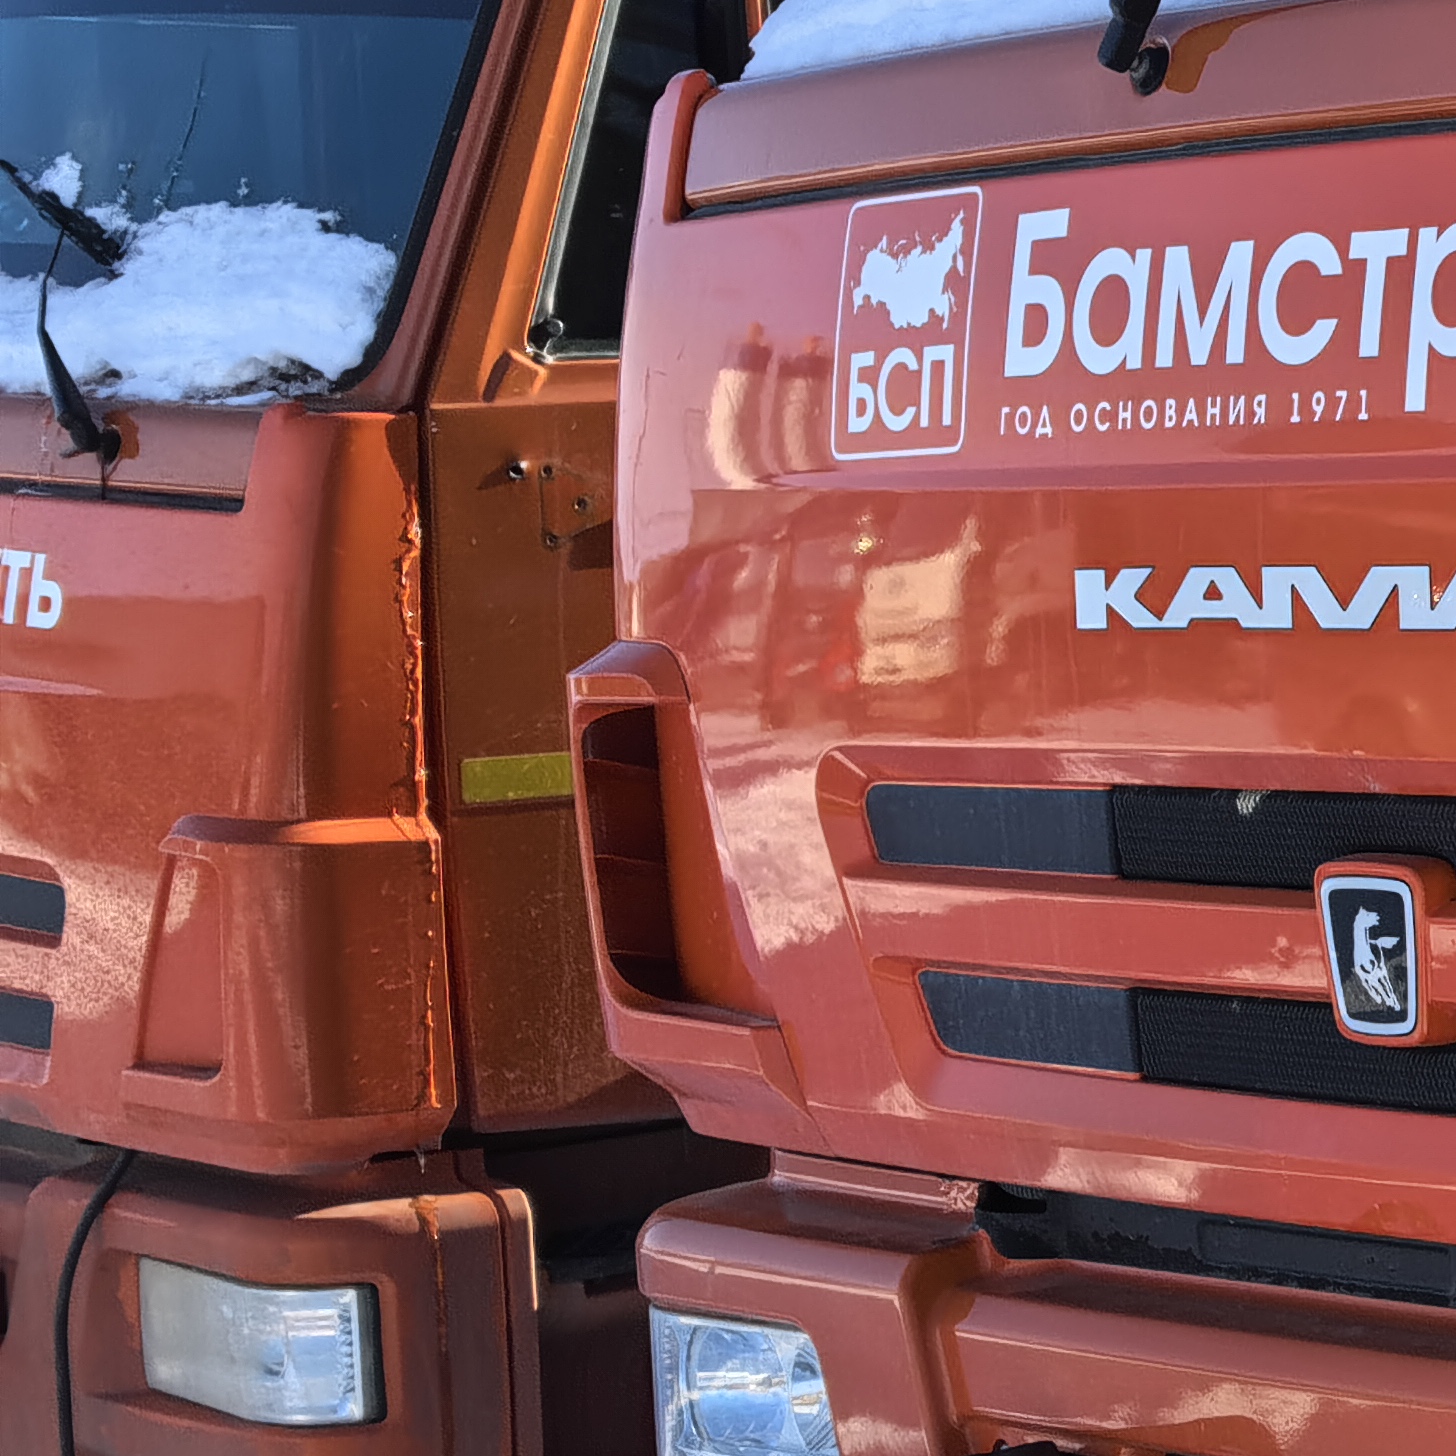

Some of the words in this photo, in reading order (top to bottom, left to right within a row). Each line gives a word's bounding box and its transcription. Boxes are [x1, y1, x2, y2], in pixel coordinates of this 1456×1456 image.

[847, 343, 955, 435] БСП
[1000, 405, 1053, 438] ГОД
[1070, 394, 1267, 433] ОСНОВАНИЯ
[1290, 389, 1370, 424] 1971
